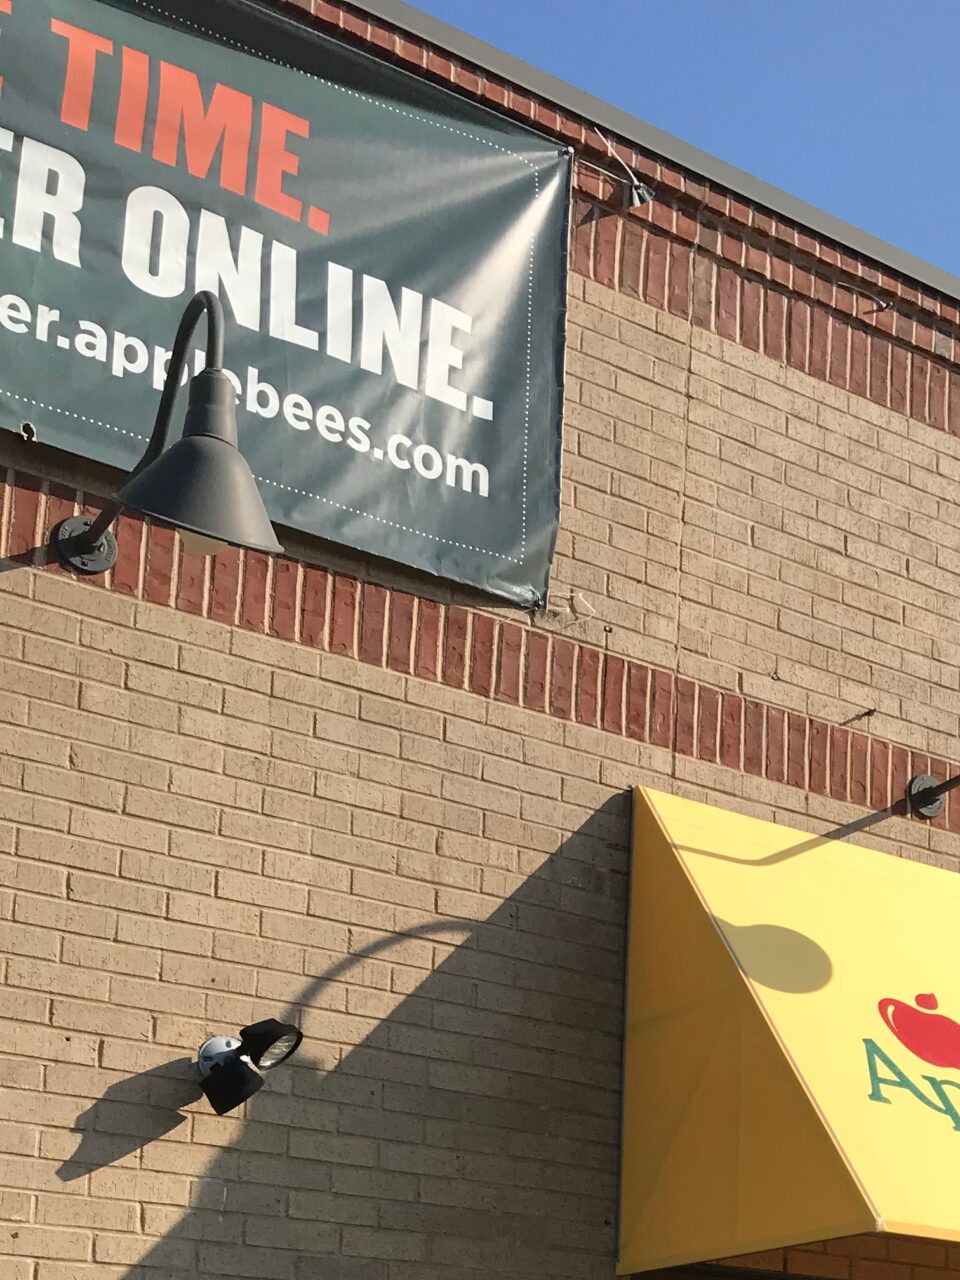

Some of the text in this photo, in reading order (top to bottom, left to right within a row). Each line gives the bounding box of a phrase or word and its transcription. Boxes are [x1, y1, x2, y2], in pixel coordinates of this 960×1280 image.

[50, 17, 331, 237] TIME.
[0, 126, 494, 421] R ONLINE.
